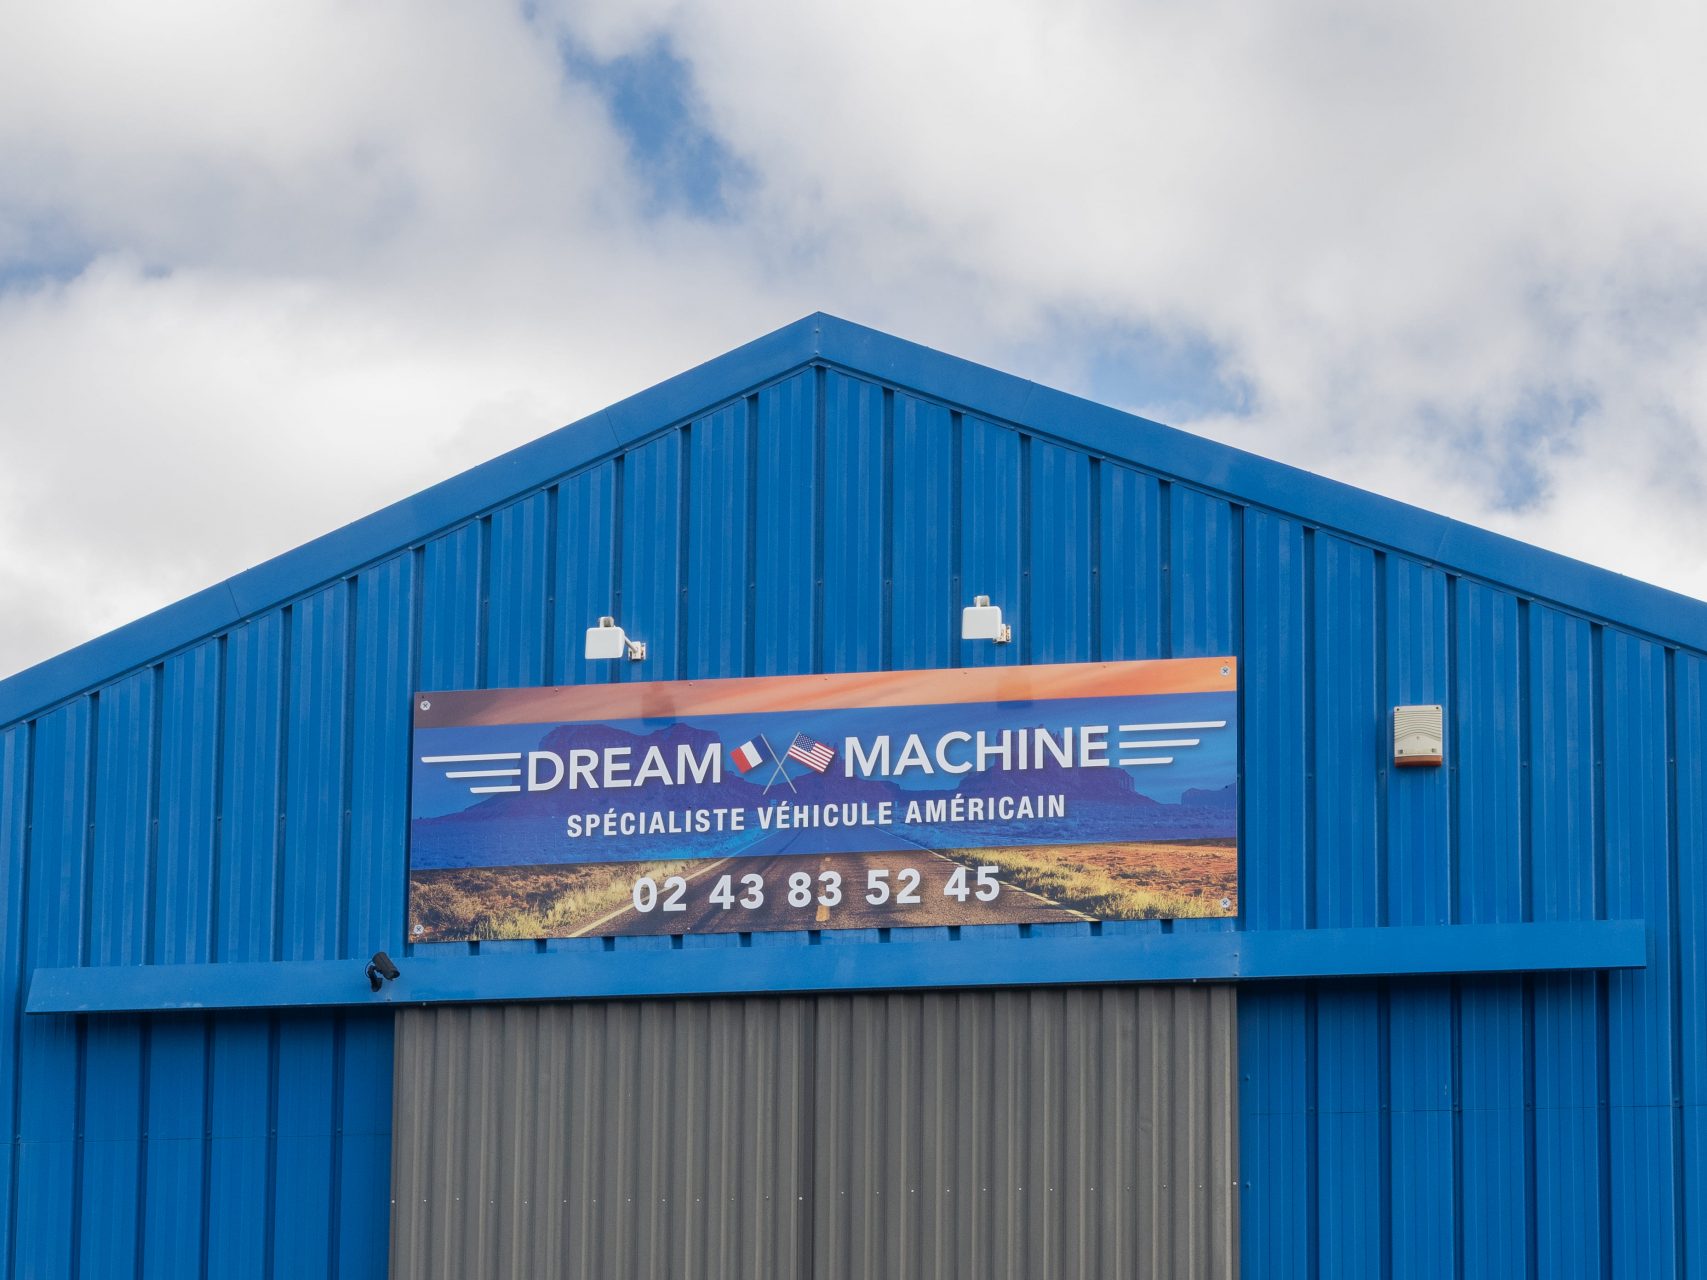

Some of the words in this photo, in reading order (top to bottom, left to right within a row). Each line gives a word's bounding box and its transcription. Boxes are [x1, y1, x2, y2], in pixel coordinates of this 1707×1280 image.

[527, 742, 722, 792] DREAM
[844, 725, 1110, 778] MACHINE
[566, 807, 745, 838] SPÉCIALISTE
[757, 801, 892, 830] VÉHICULE
[904, 794, 1066, 824] AMÉRICAIN
[632, 876, 687, 913] 02
[708, 873, 764, 910] 43
[787, 871, 842, 908] 83
[865, 868, 921, 905] 52
[943, 865, 1000, 902] 45
